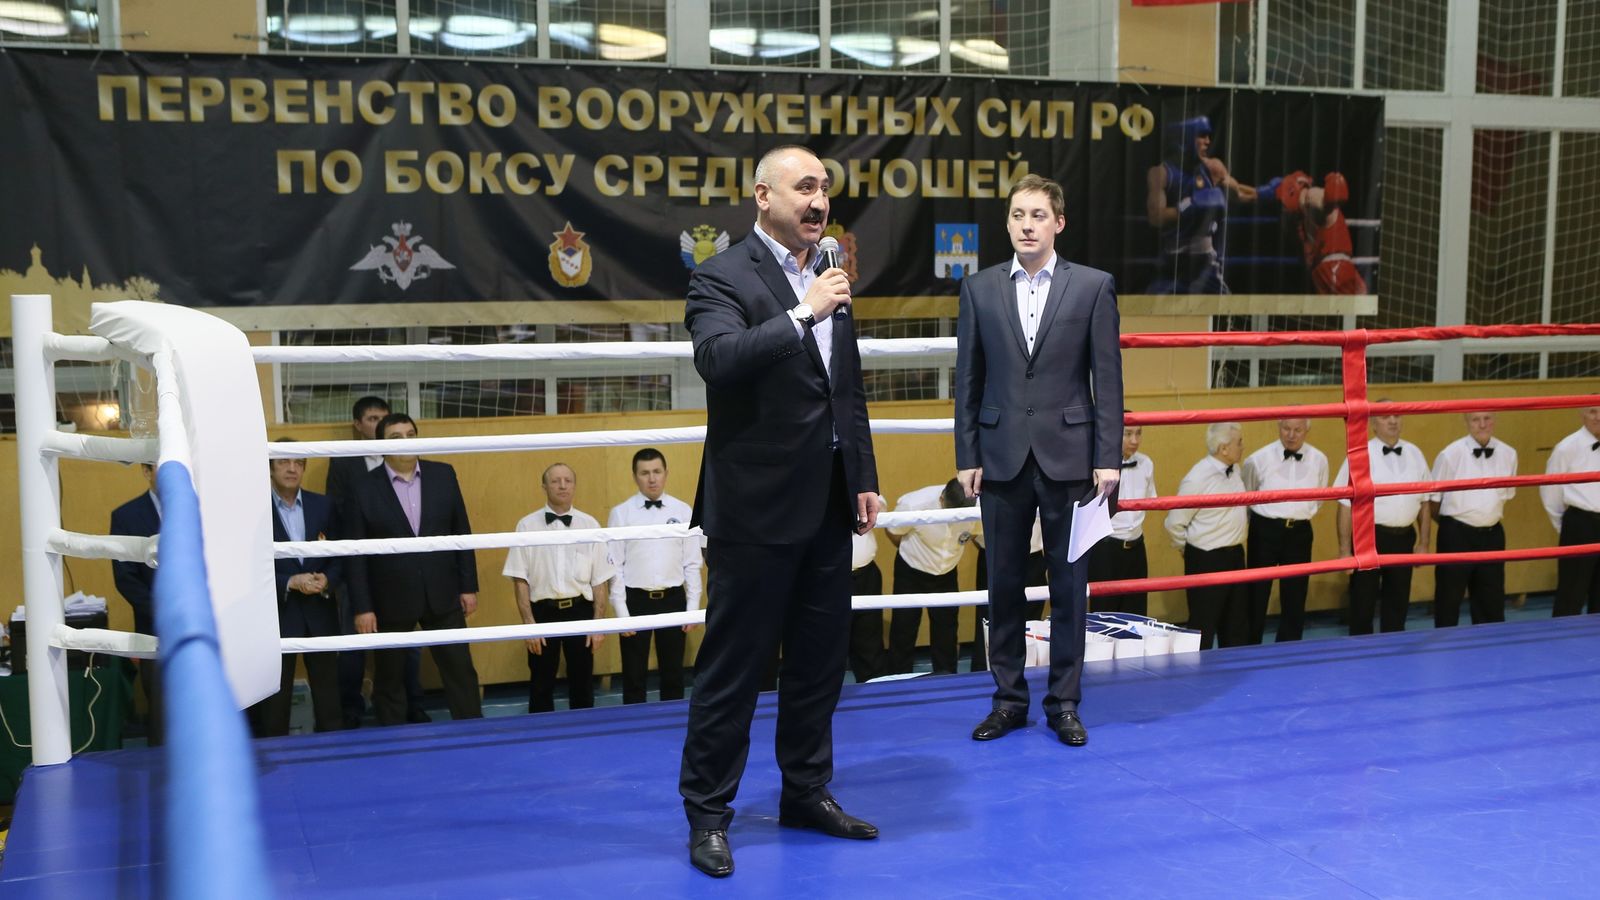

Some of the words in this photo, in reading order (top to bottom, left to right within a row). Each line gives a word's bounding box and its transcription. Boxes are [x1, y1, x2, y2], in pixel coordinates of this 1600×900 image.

[97, 74, 517, 128] ПЕРВЕНСТВО
[537, 86, 962, 137] ВООРУЖЕННЫХ
[976, 97, 1075, 139] СИЛ
[1091, 102, 1155, 141] РФ
[276, 149, 363, 195] ПО
[384, 150, 576, 196] БОКСУ
